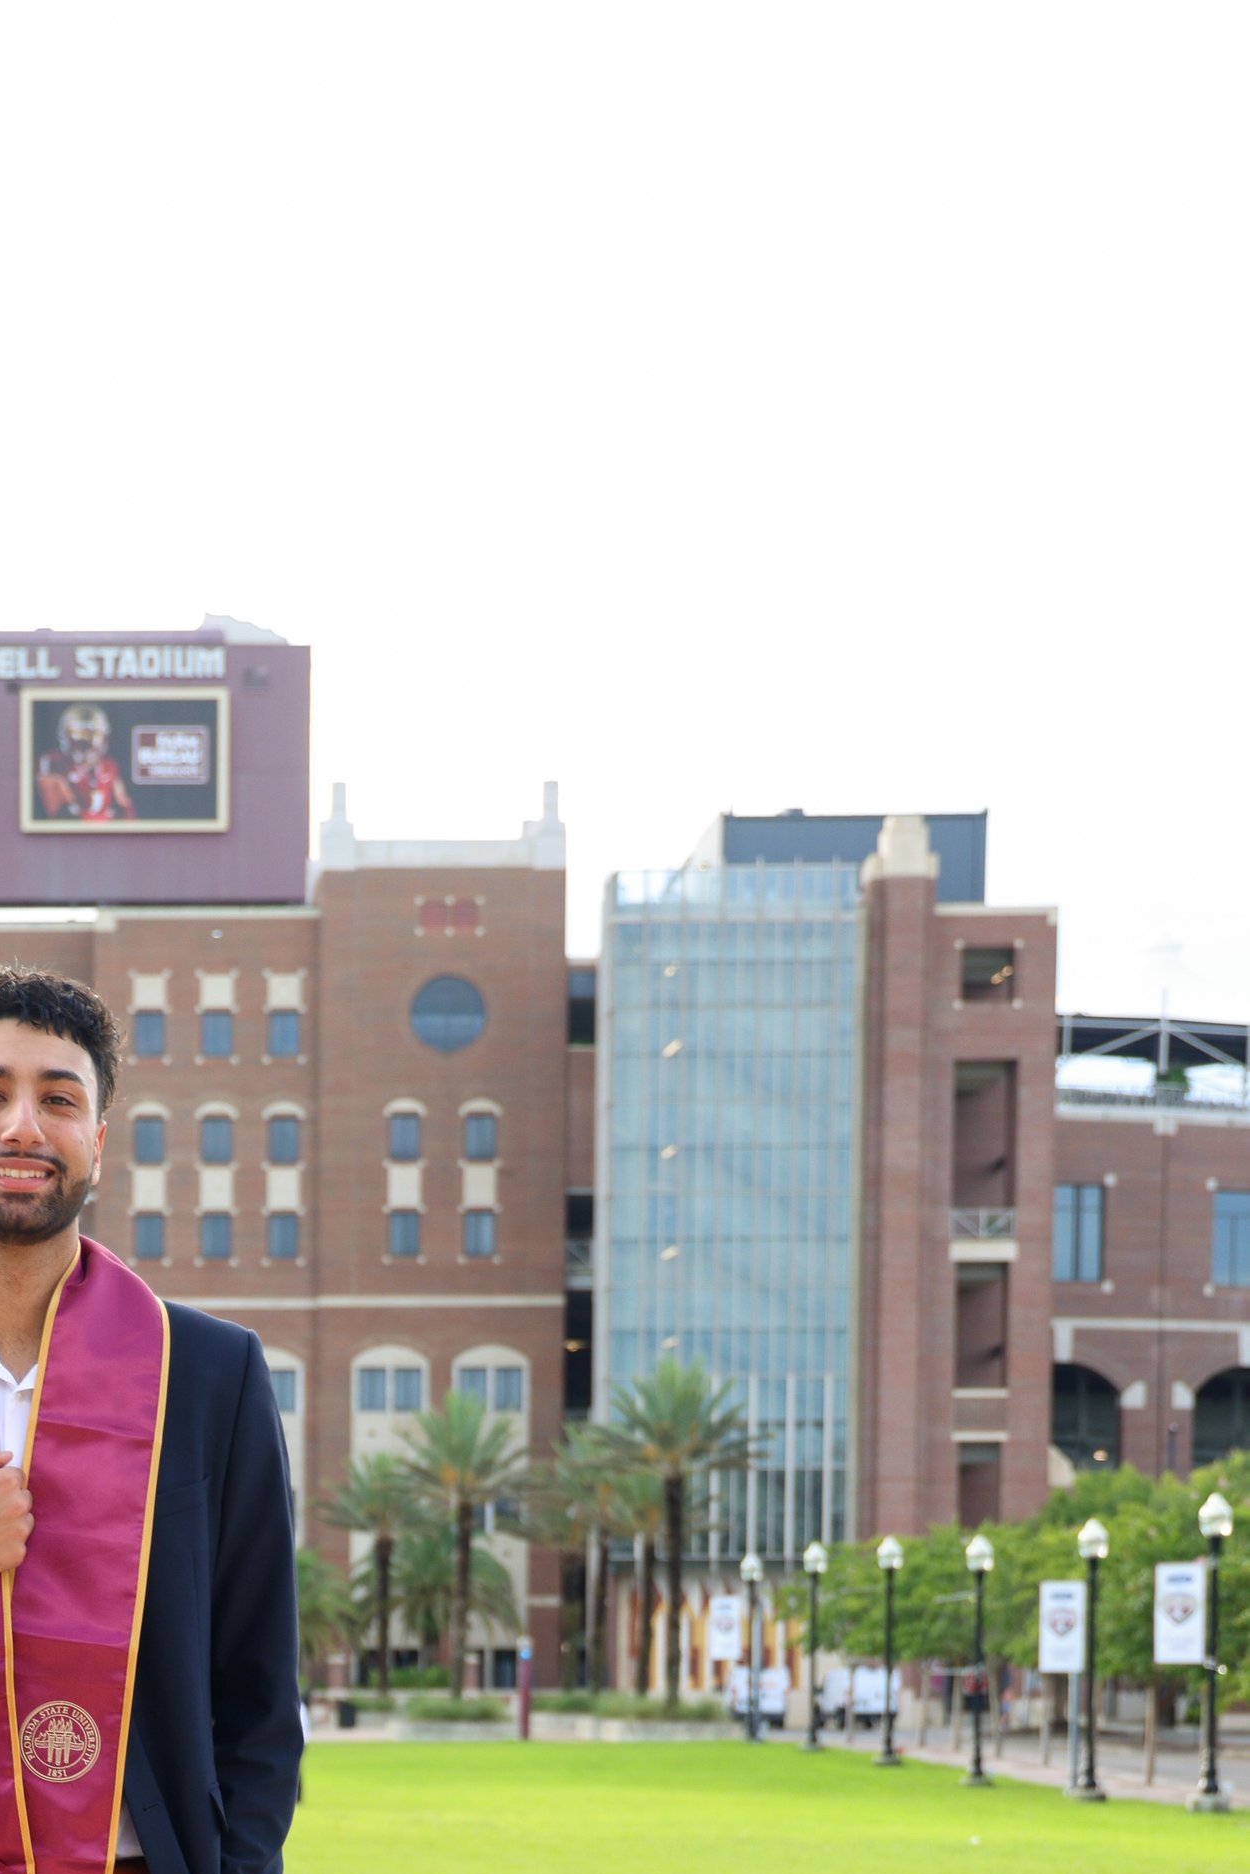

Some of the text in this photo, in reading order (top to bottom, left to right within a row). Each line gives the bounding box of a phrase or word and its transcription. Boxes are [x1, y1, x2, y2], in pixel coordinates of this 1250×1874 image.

[74, 646, 226, 679] STADIUM
[23, 1706, 96, 1766] FLORIDA STATE UNIVERSITY
[47, 1768, 68, 1778] 1851
